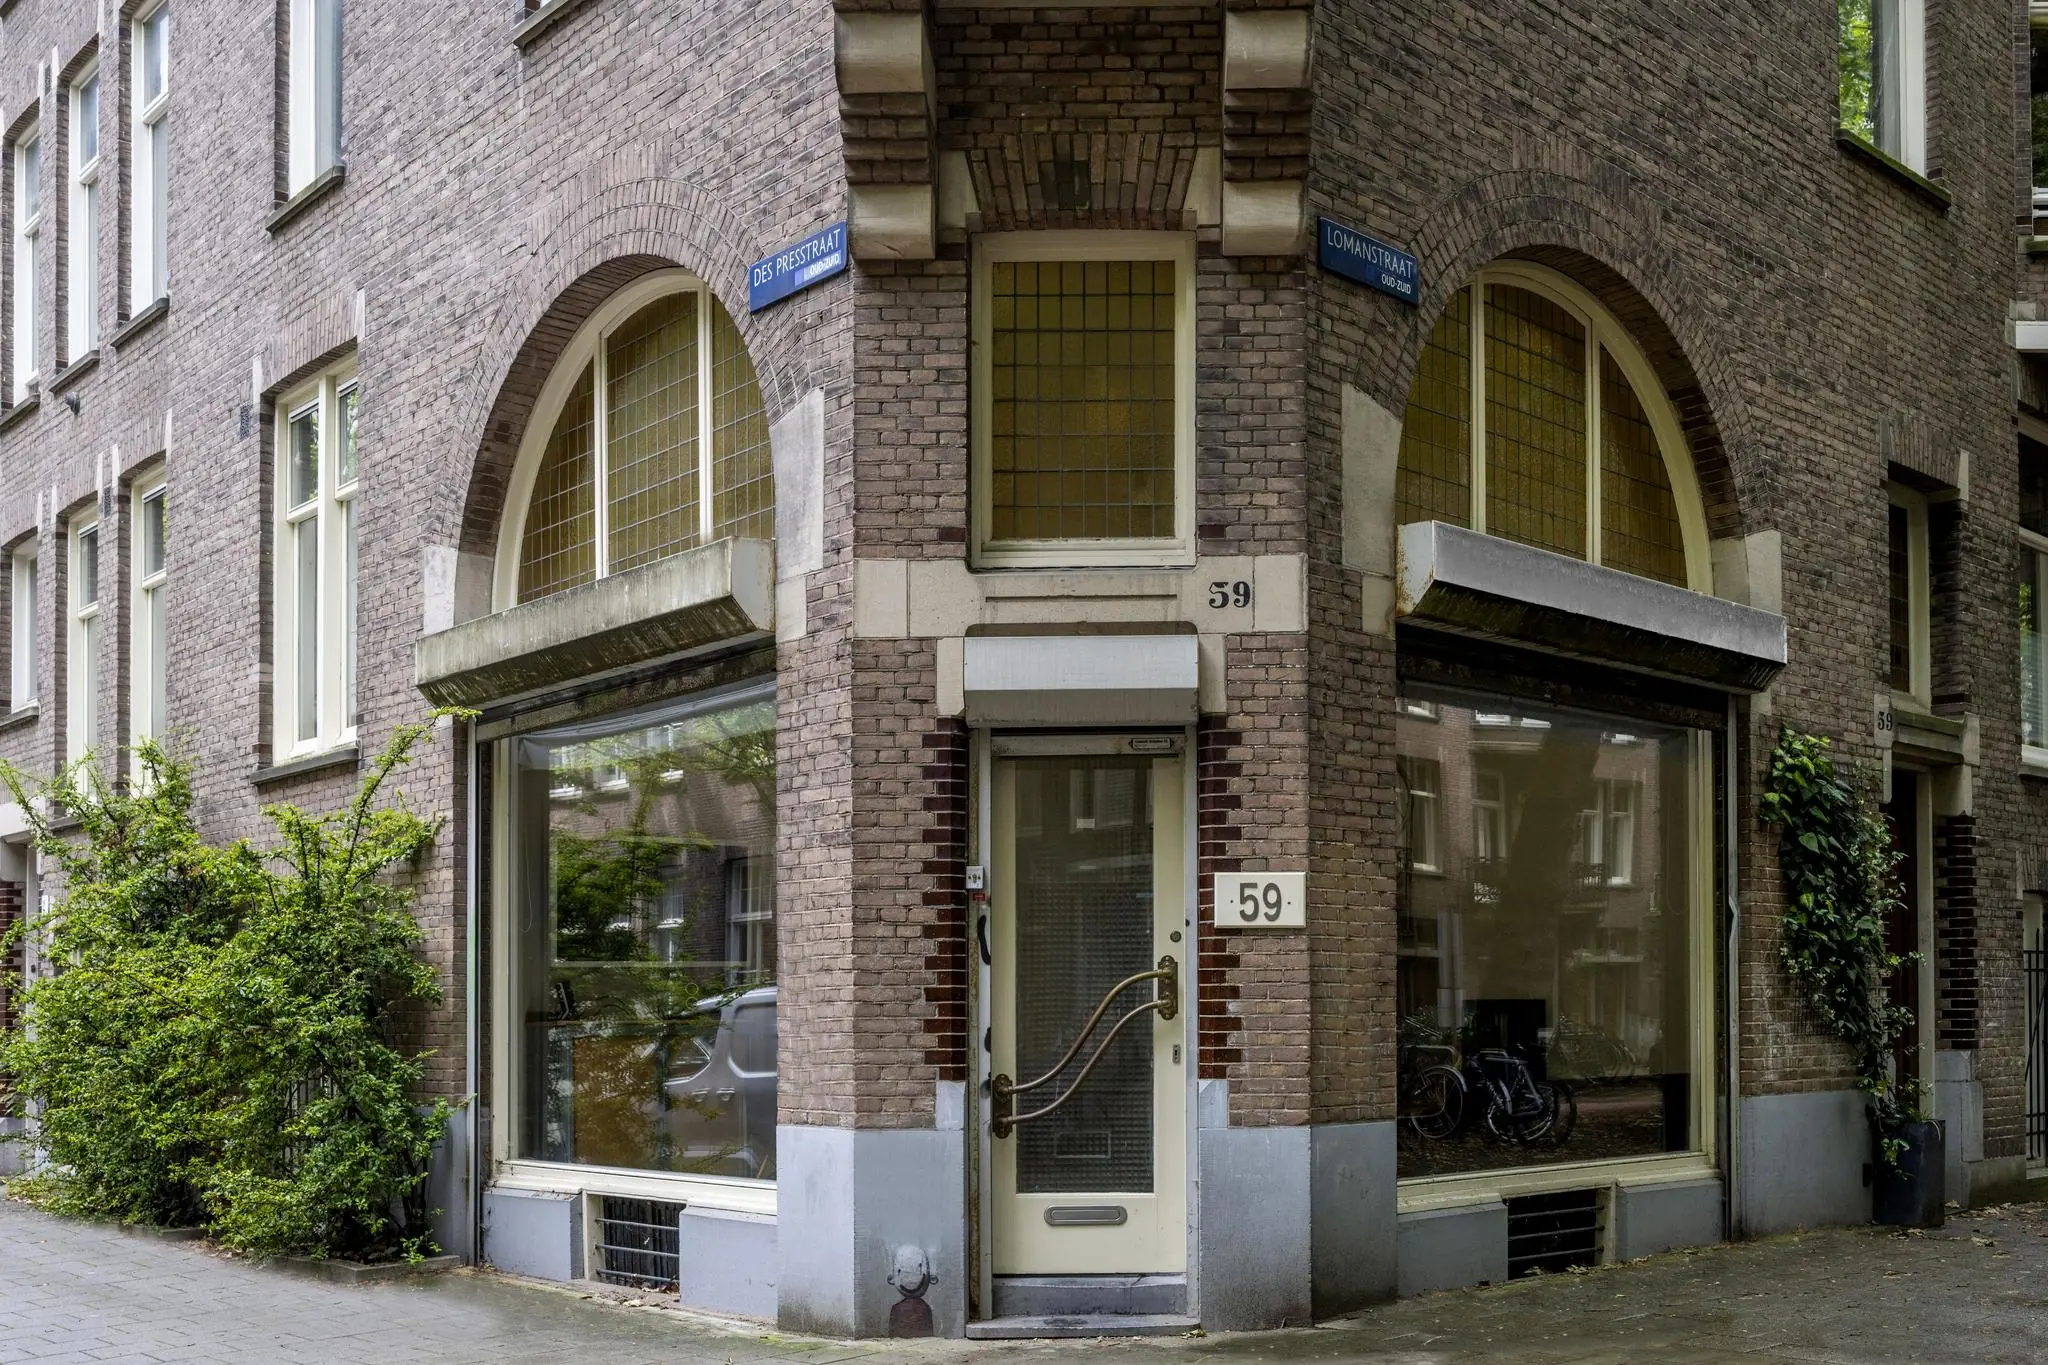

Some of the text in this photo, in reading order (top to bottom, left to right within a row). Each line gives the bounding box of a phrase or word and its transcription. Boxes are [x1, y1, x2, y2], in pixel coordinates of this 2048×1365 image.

[754, 229, 841, 287] DES PRESSTRAAT
[1327, 226, 1413, 279] LOMANSTRAAT
[1381, 273, 1412, 295] OUD-ZUID
[1208, 581, 1251, 609] 59
[1877, 711, 1893, 731] 59
[1239, 882, 1282, 922] 59
